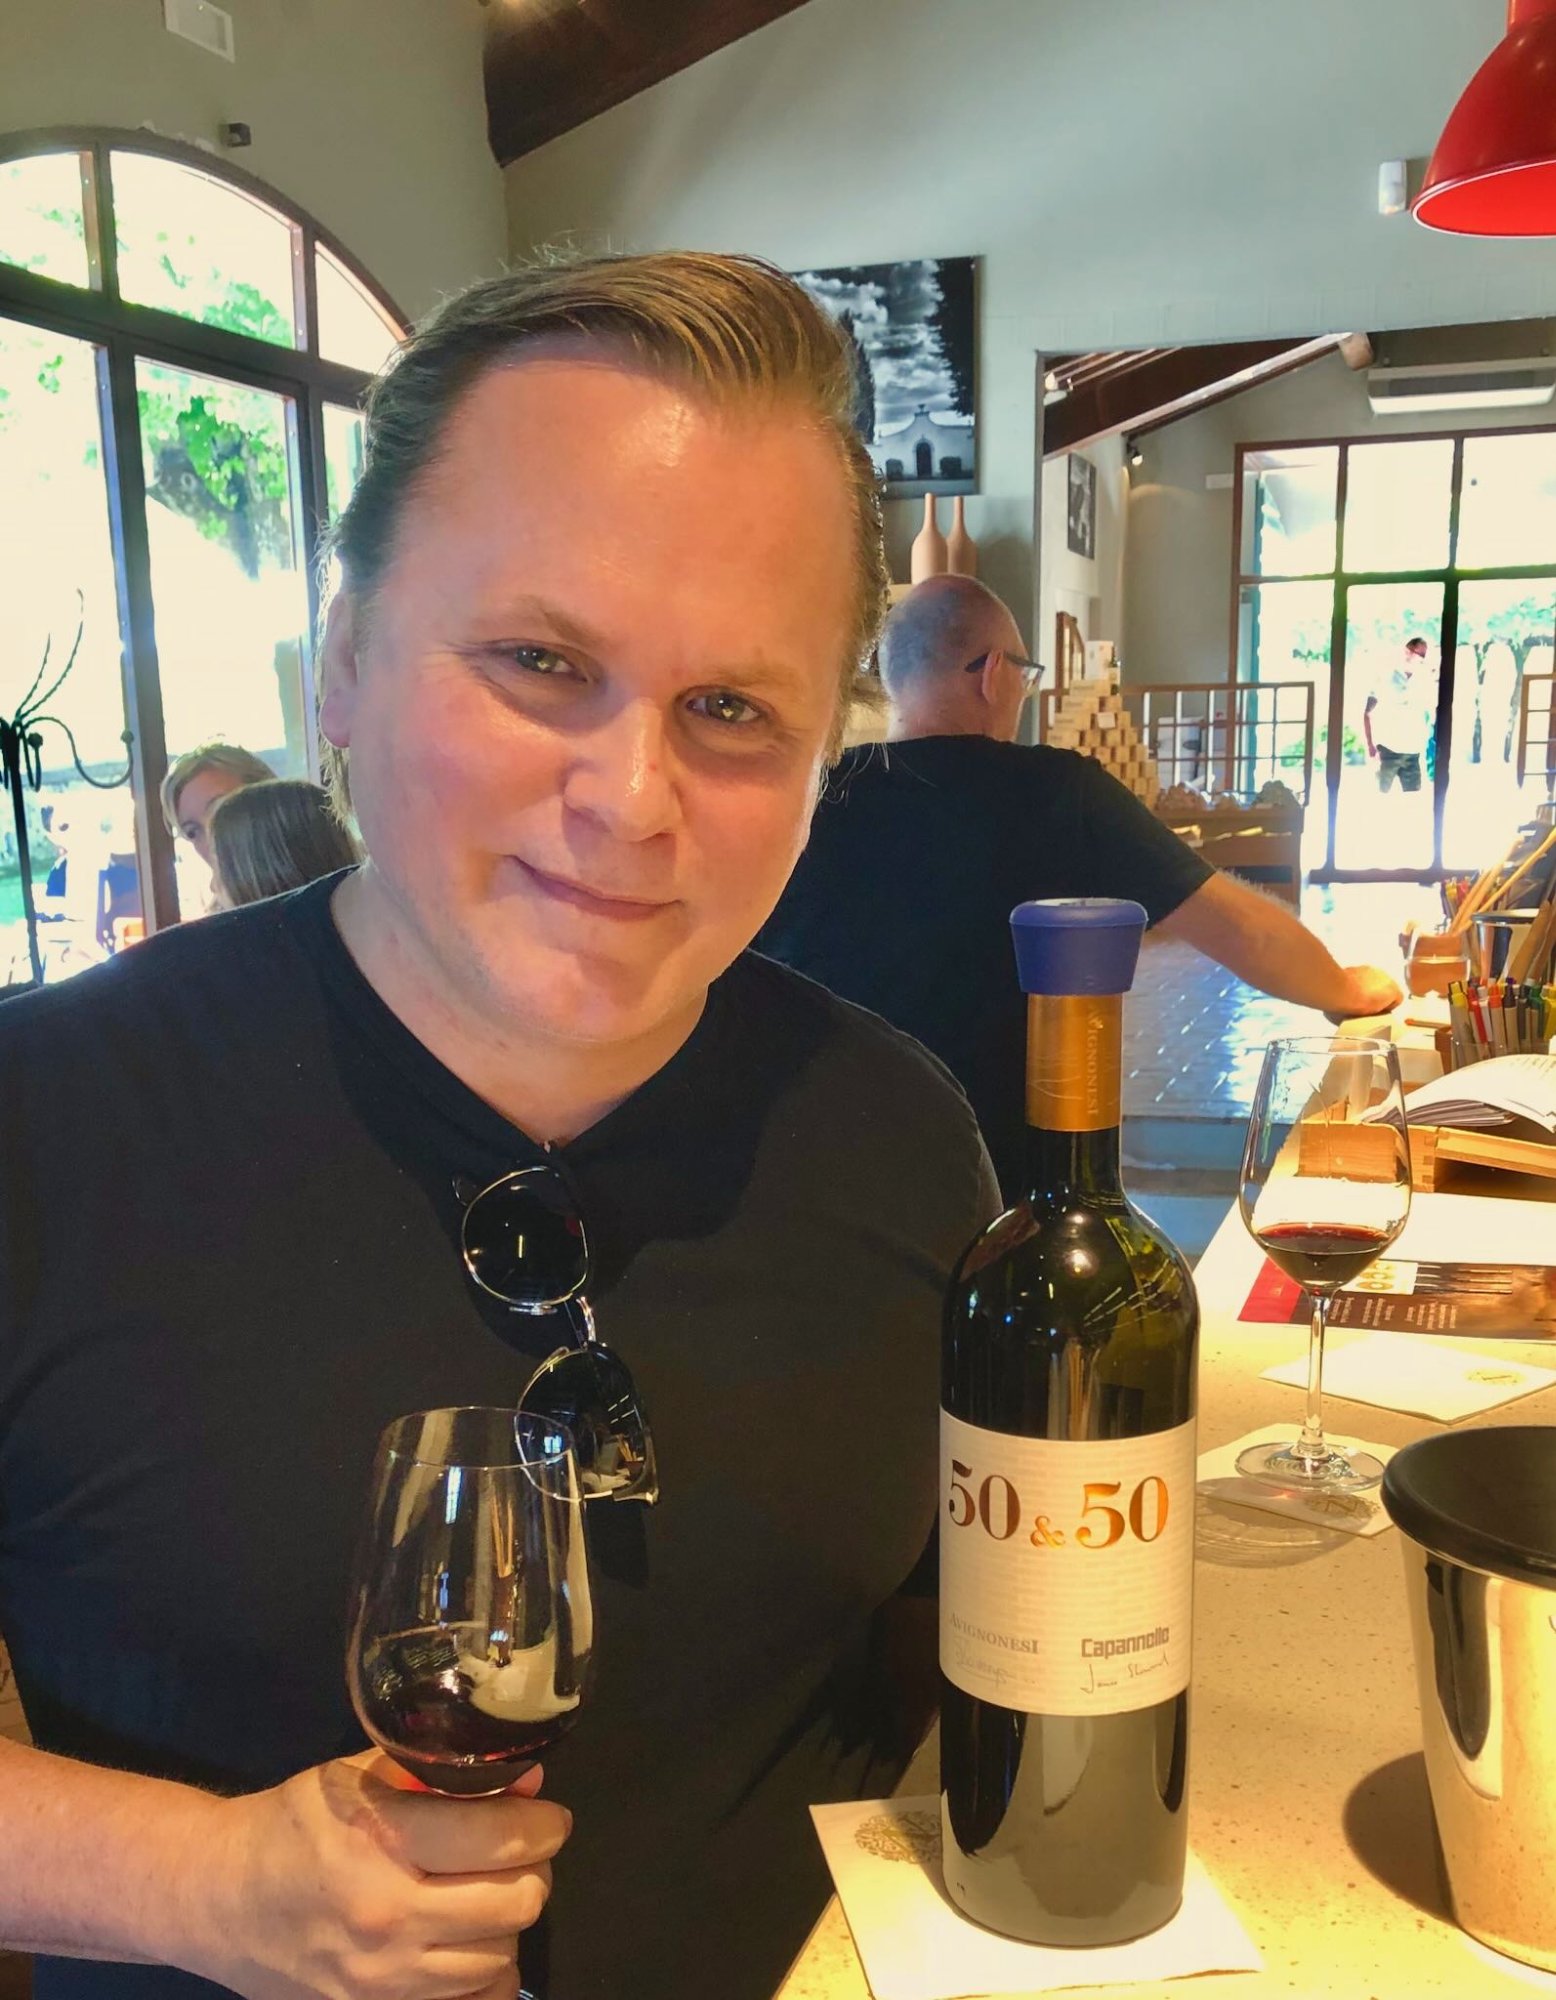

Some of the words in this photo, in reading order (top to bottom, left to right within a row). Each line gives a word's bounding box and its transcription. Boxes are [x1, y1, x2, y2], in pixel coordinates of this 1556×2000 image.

[948, 1459, 1020, 1540] 50
[1030, 1515, 1066, 1549] &
[1075, 1476, 1169, 1549] 50
